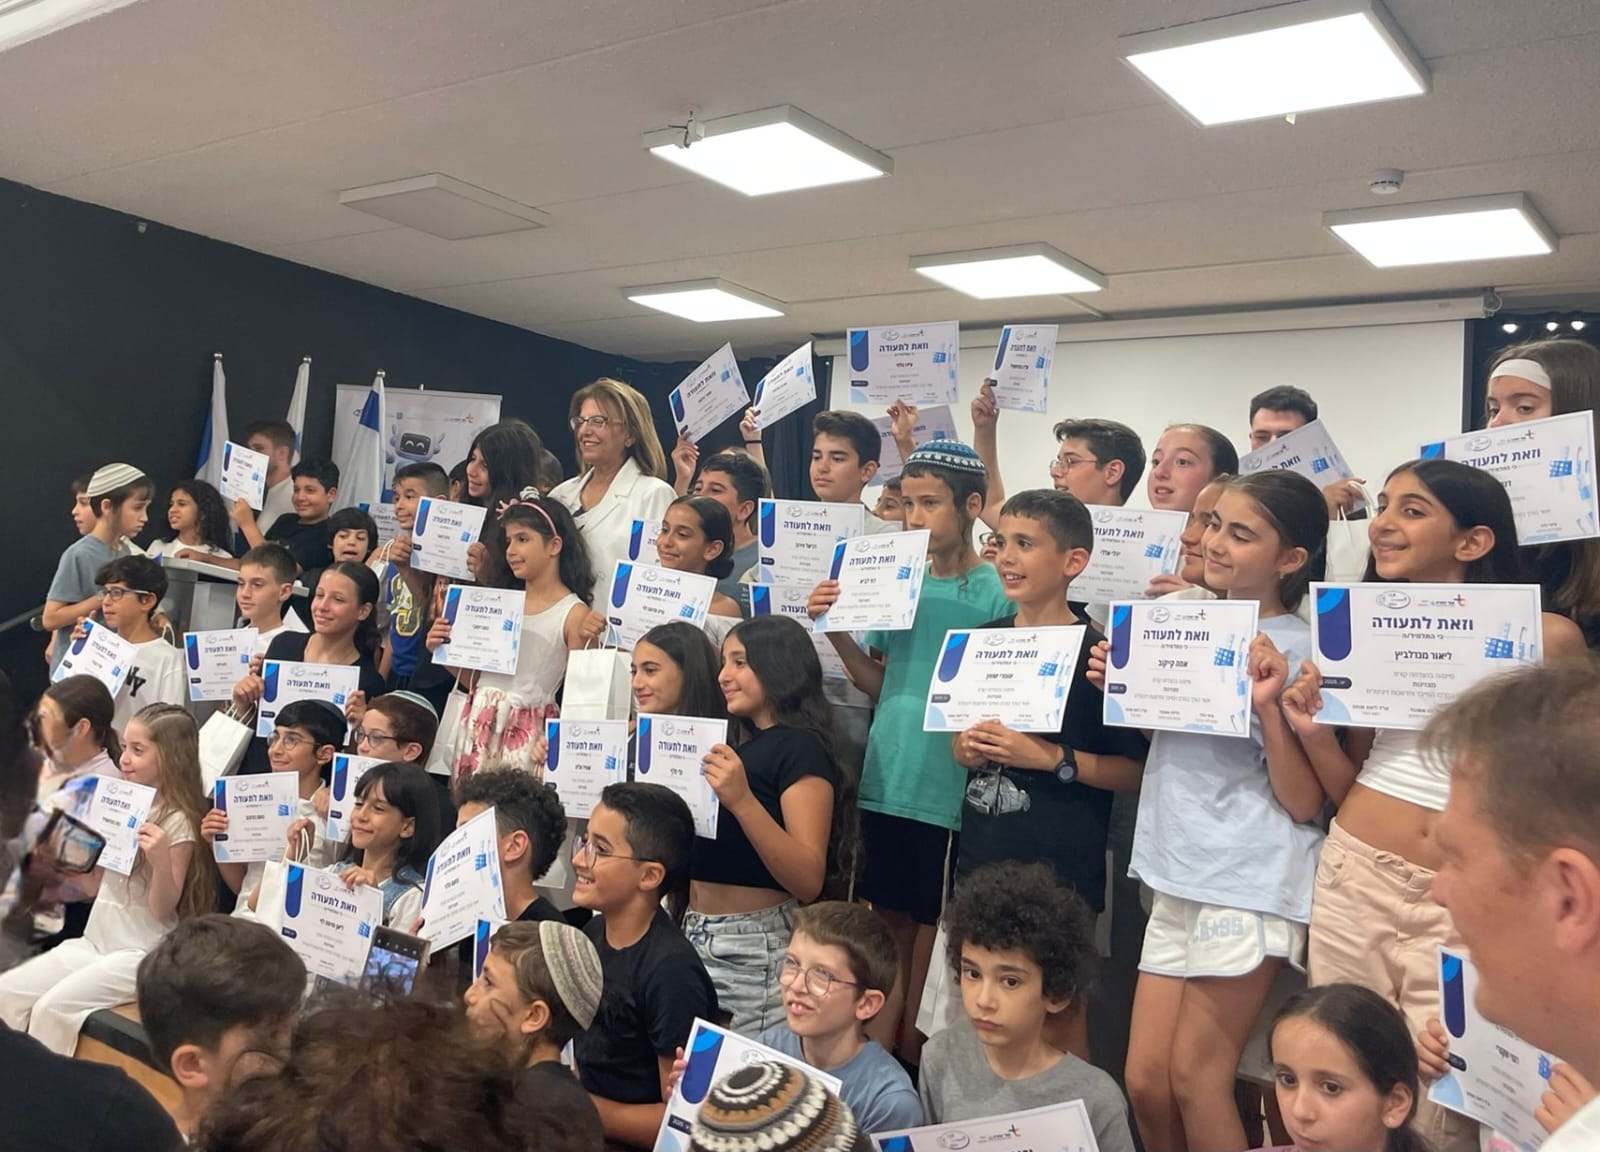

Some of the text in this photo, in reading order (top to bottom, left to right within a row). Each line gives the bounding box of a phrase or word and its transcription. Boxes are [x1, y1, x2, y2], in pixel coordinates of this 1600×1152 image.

[880, 343, 908, 352] לתעודה
[1512, 448, 1541, 461] וזאת
[1280, 456, 1302, 470] וזאת
[784, 520, 831, 532] וזאת לתעודה
[1094, 527, 1144, 539] וזאת לתעוד
[849, 555, 896, 566] וזאת לתעודה
[636, 583, 663, 596] לתעודה
[781, 604, 806, 614] תעודה
[1372, 616, 1473, 630] וזאת לתעודה
[1143, 628, 1210, 642] וזאת לתעודה
[975, 650, 1038, 659] וזאת לתעודה
[1430, 651, 1452, 660] ליאור
[286, 679, 313, 687] לתעודה
[566, 740, 588, 750] לתעודה
[658, 740, 682, 751] לתעודה
[311, 891, 357, 913] וזאת לתעודה
